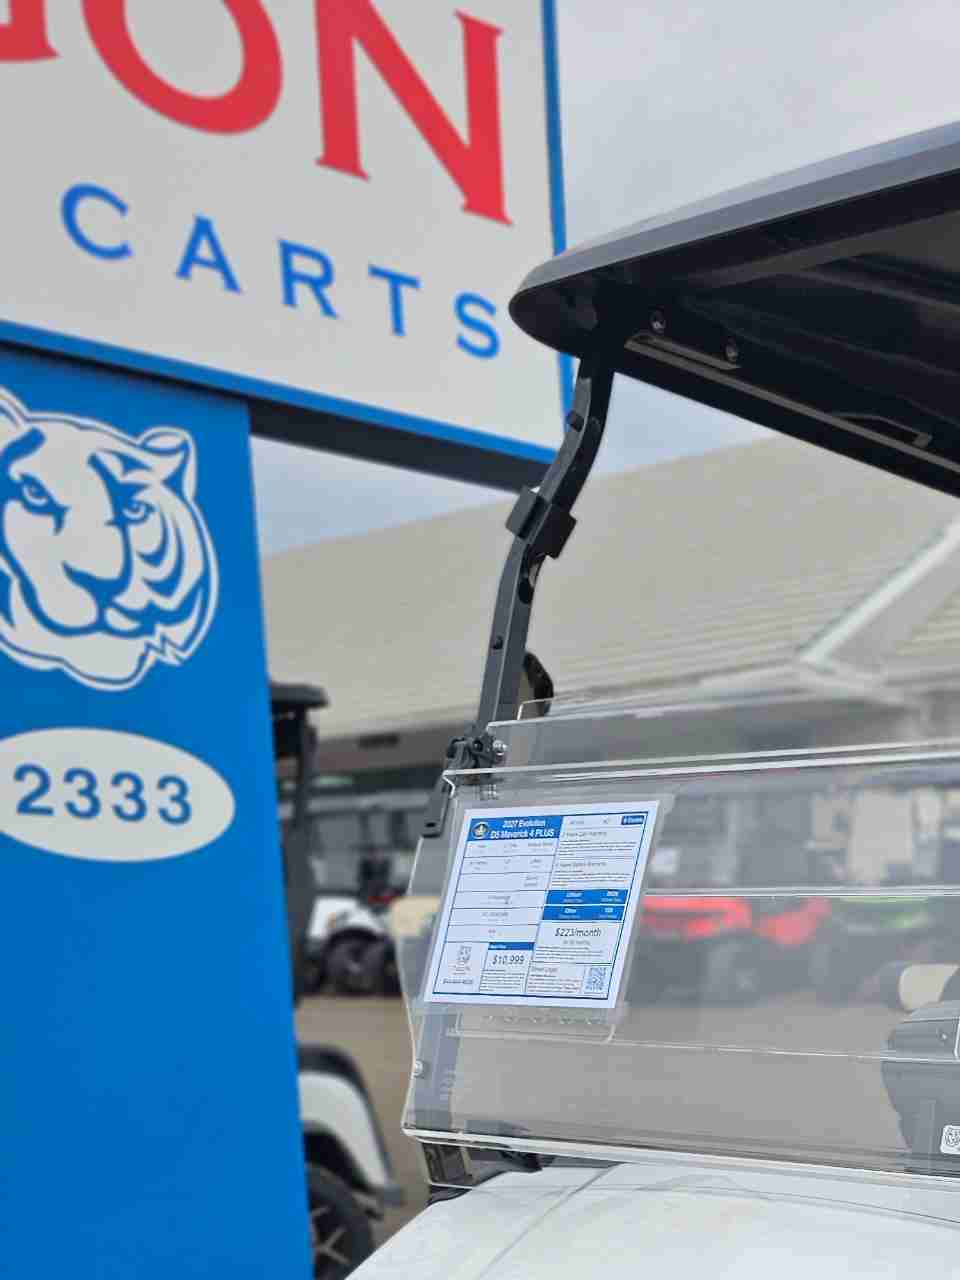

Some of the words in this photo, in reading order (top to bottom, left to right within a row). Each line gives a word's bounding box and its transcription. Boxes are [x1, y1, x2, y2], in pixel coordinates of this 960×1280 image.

[0, 0, 513, 226] ON
[60, 183, 502, 360] CARTS
[14, 763, 193, 826] 2333
[535, 829, 555, 838] PLUS
